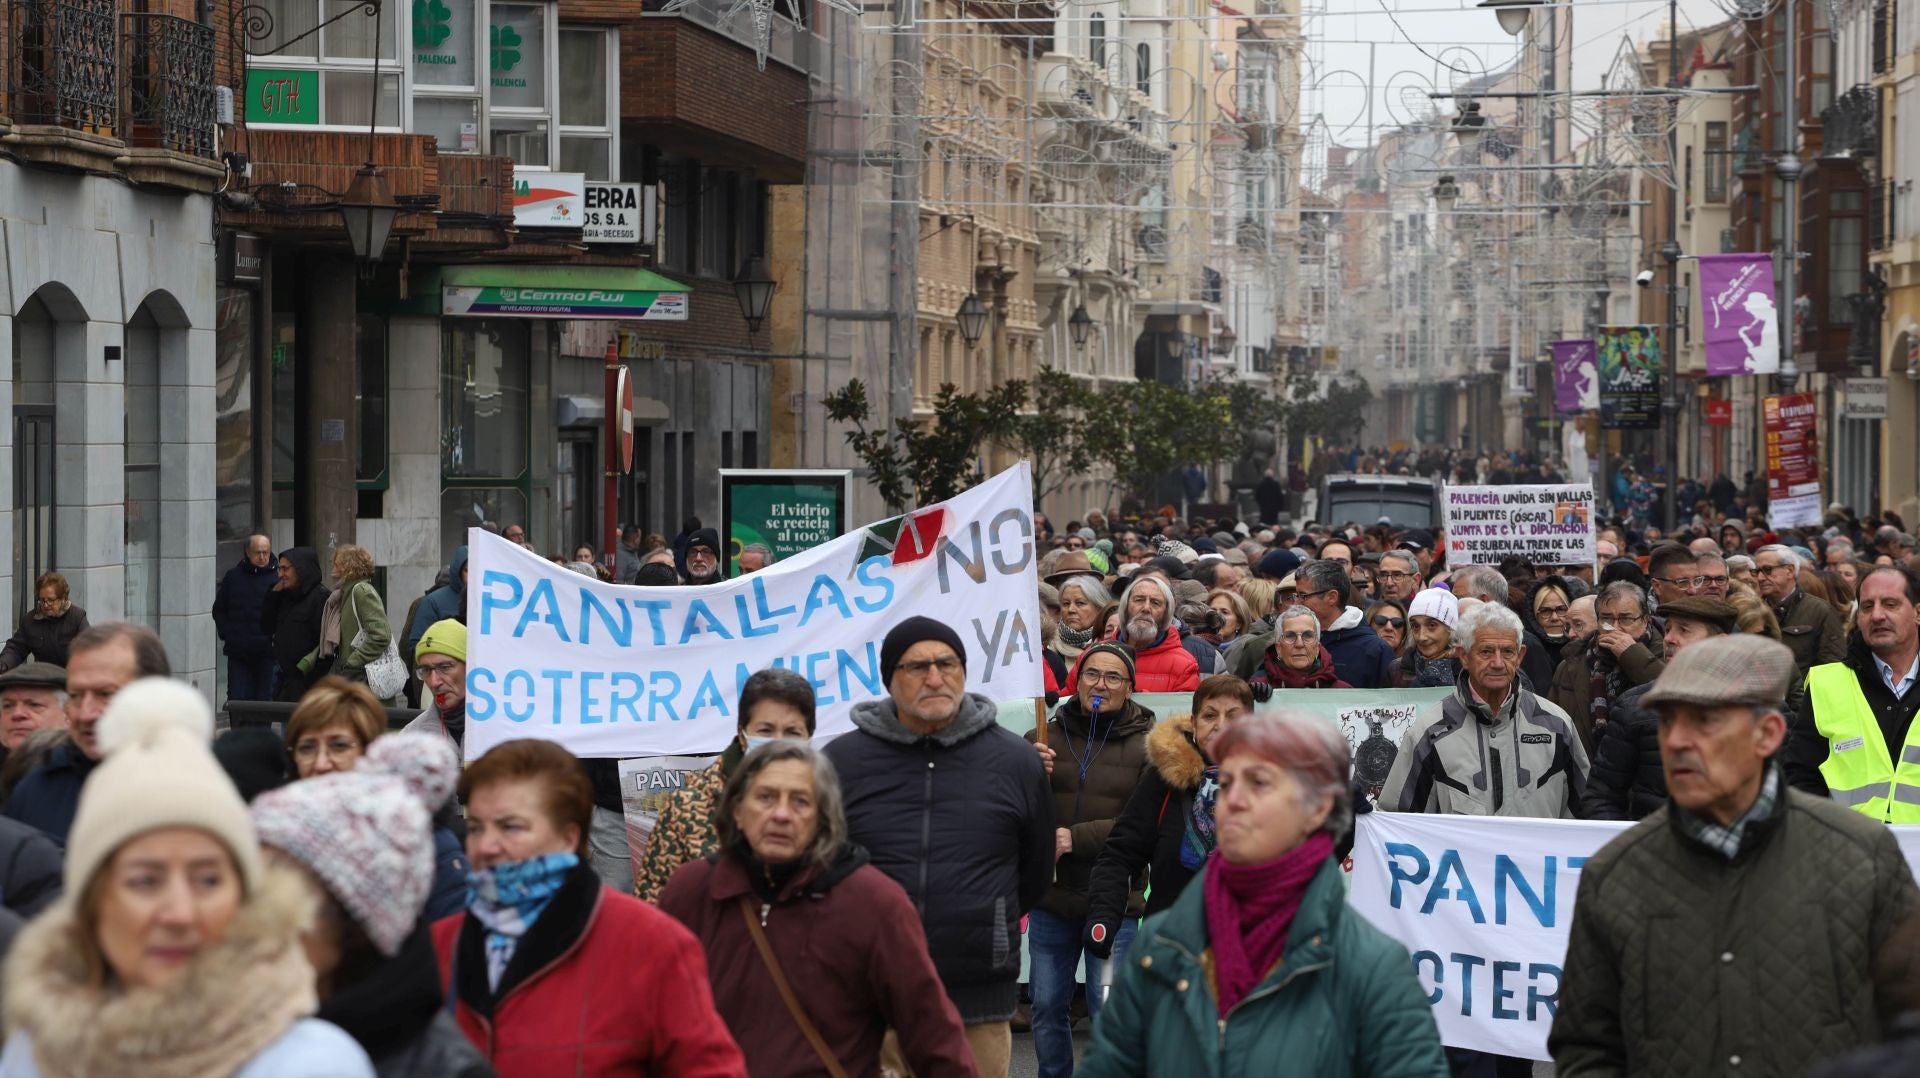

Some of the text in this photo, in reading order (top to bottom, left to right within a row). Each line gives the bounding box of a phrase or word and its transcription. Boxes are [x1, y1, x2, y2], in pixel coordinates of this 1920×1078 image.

[417, 54, 457, 64] PALENCIA
[490, 78, 527, 87] PALENCIA
[261, 77, 300, 117] GTH
[585, 187, 637, 209] ERRA
[1450, 489, 1593, 504] PALENCIA UNIDA SIN VALLAS
[771, 503, 830, 517] El vidrio
[1450, 508, 1461, 520] NI
[1463, 510, 1507, 521] PUENTES
[766, 516, 830, 530] se recicla
[1451, 525, 1482, 536] JUNTA
[1485, 525, 1498, 536] DE
[1500, 525, 1508, 535] C
[1510, 524, 1517, 535] Y
[1519, 525, 1526, 535] L
[777, 528, 830, 542] al 100%
[1452, 539, 1585, 551] NO SE SUBEN AL TREN DE LAS
[480, 508, 1032, 648] PANTALLAS NO
[971, 609, 1034, 683] YA
[1522, 734, 1551, 743] SPYDER
